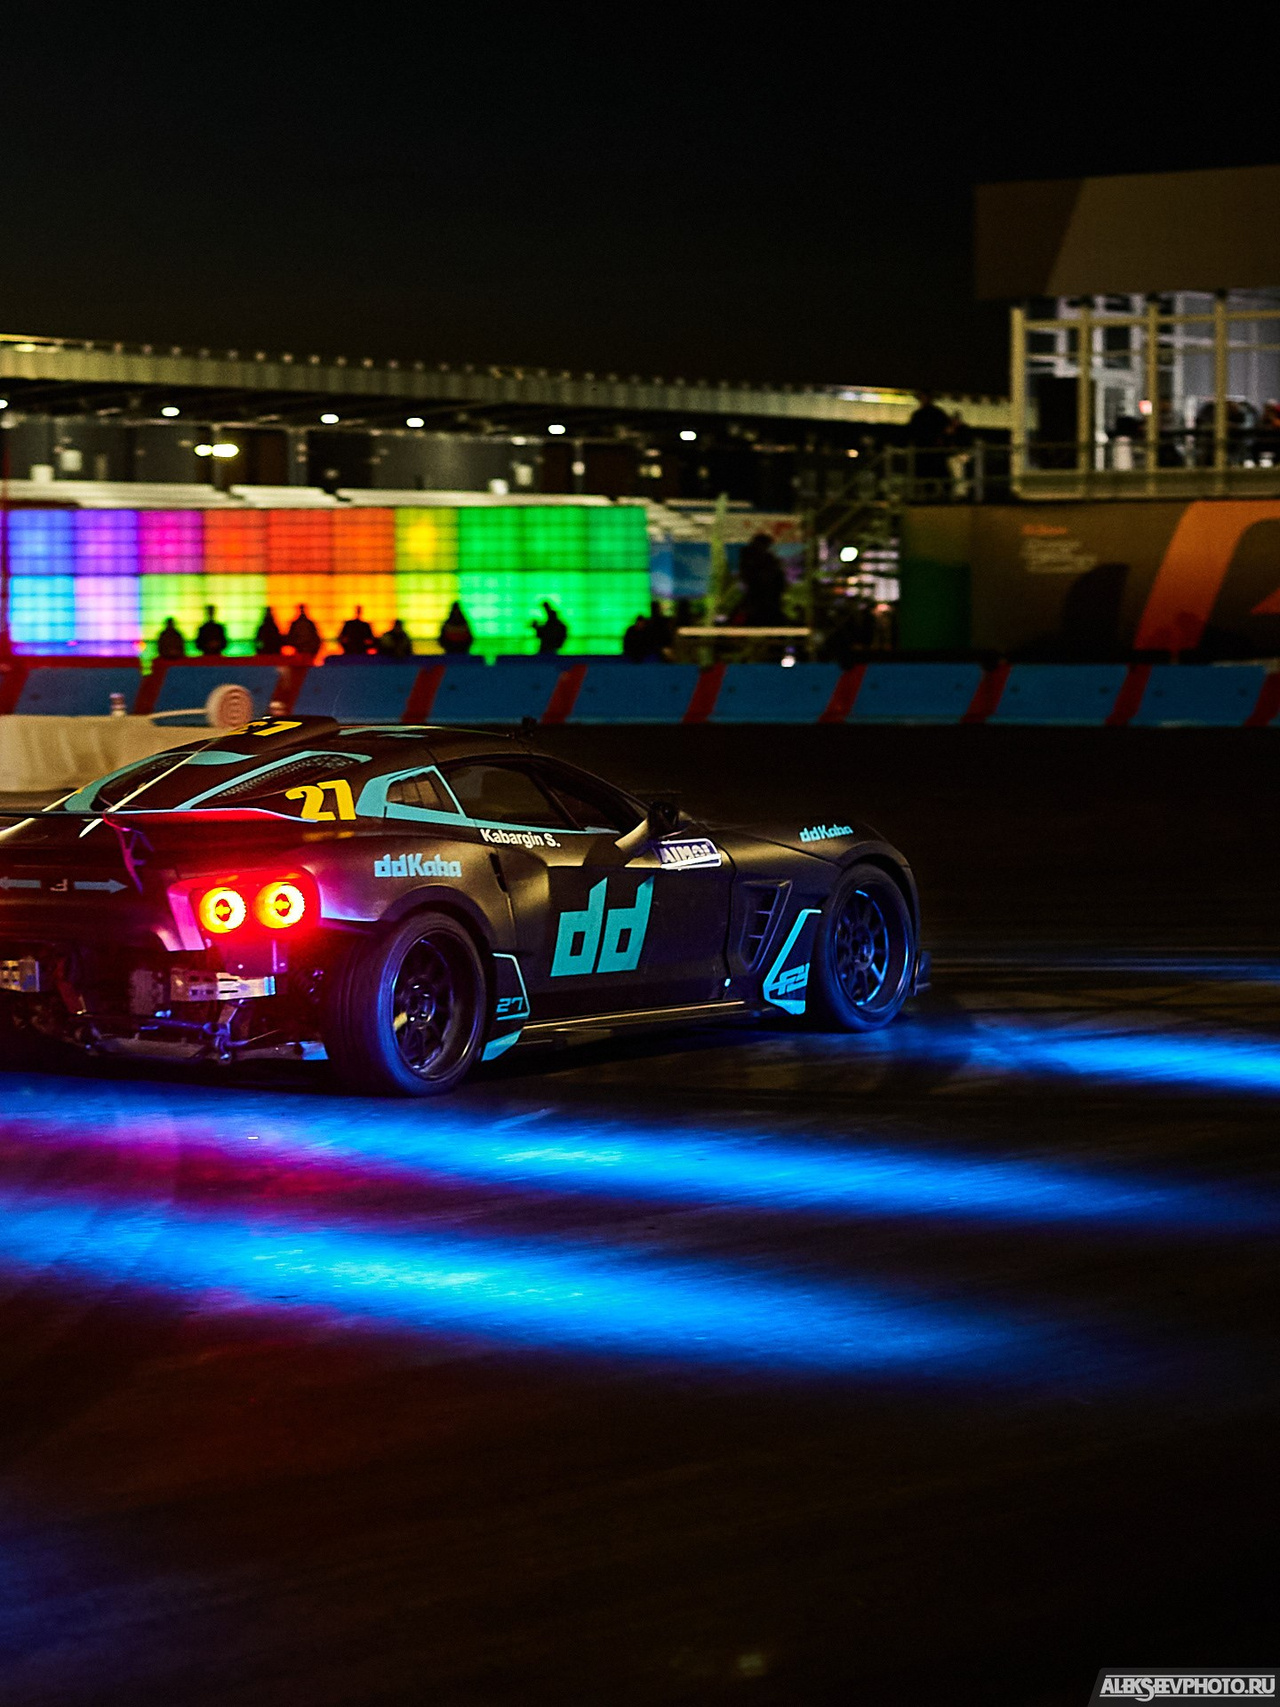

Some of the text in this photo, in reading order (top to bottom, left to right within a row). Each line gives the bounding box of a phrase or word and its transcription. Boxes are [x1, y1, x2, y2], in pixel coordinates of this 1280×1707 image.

[285, 779, 357, 821] 27
[479, 828, 562, 849] Kabargin S.
[799, 824, 854, 843] ddKaba
[374, 853, 462, 878] ddKaba
[550, 875, 655, 977] dd
[496, 996, 524, 1013] 27
